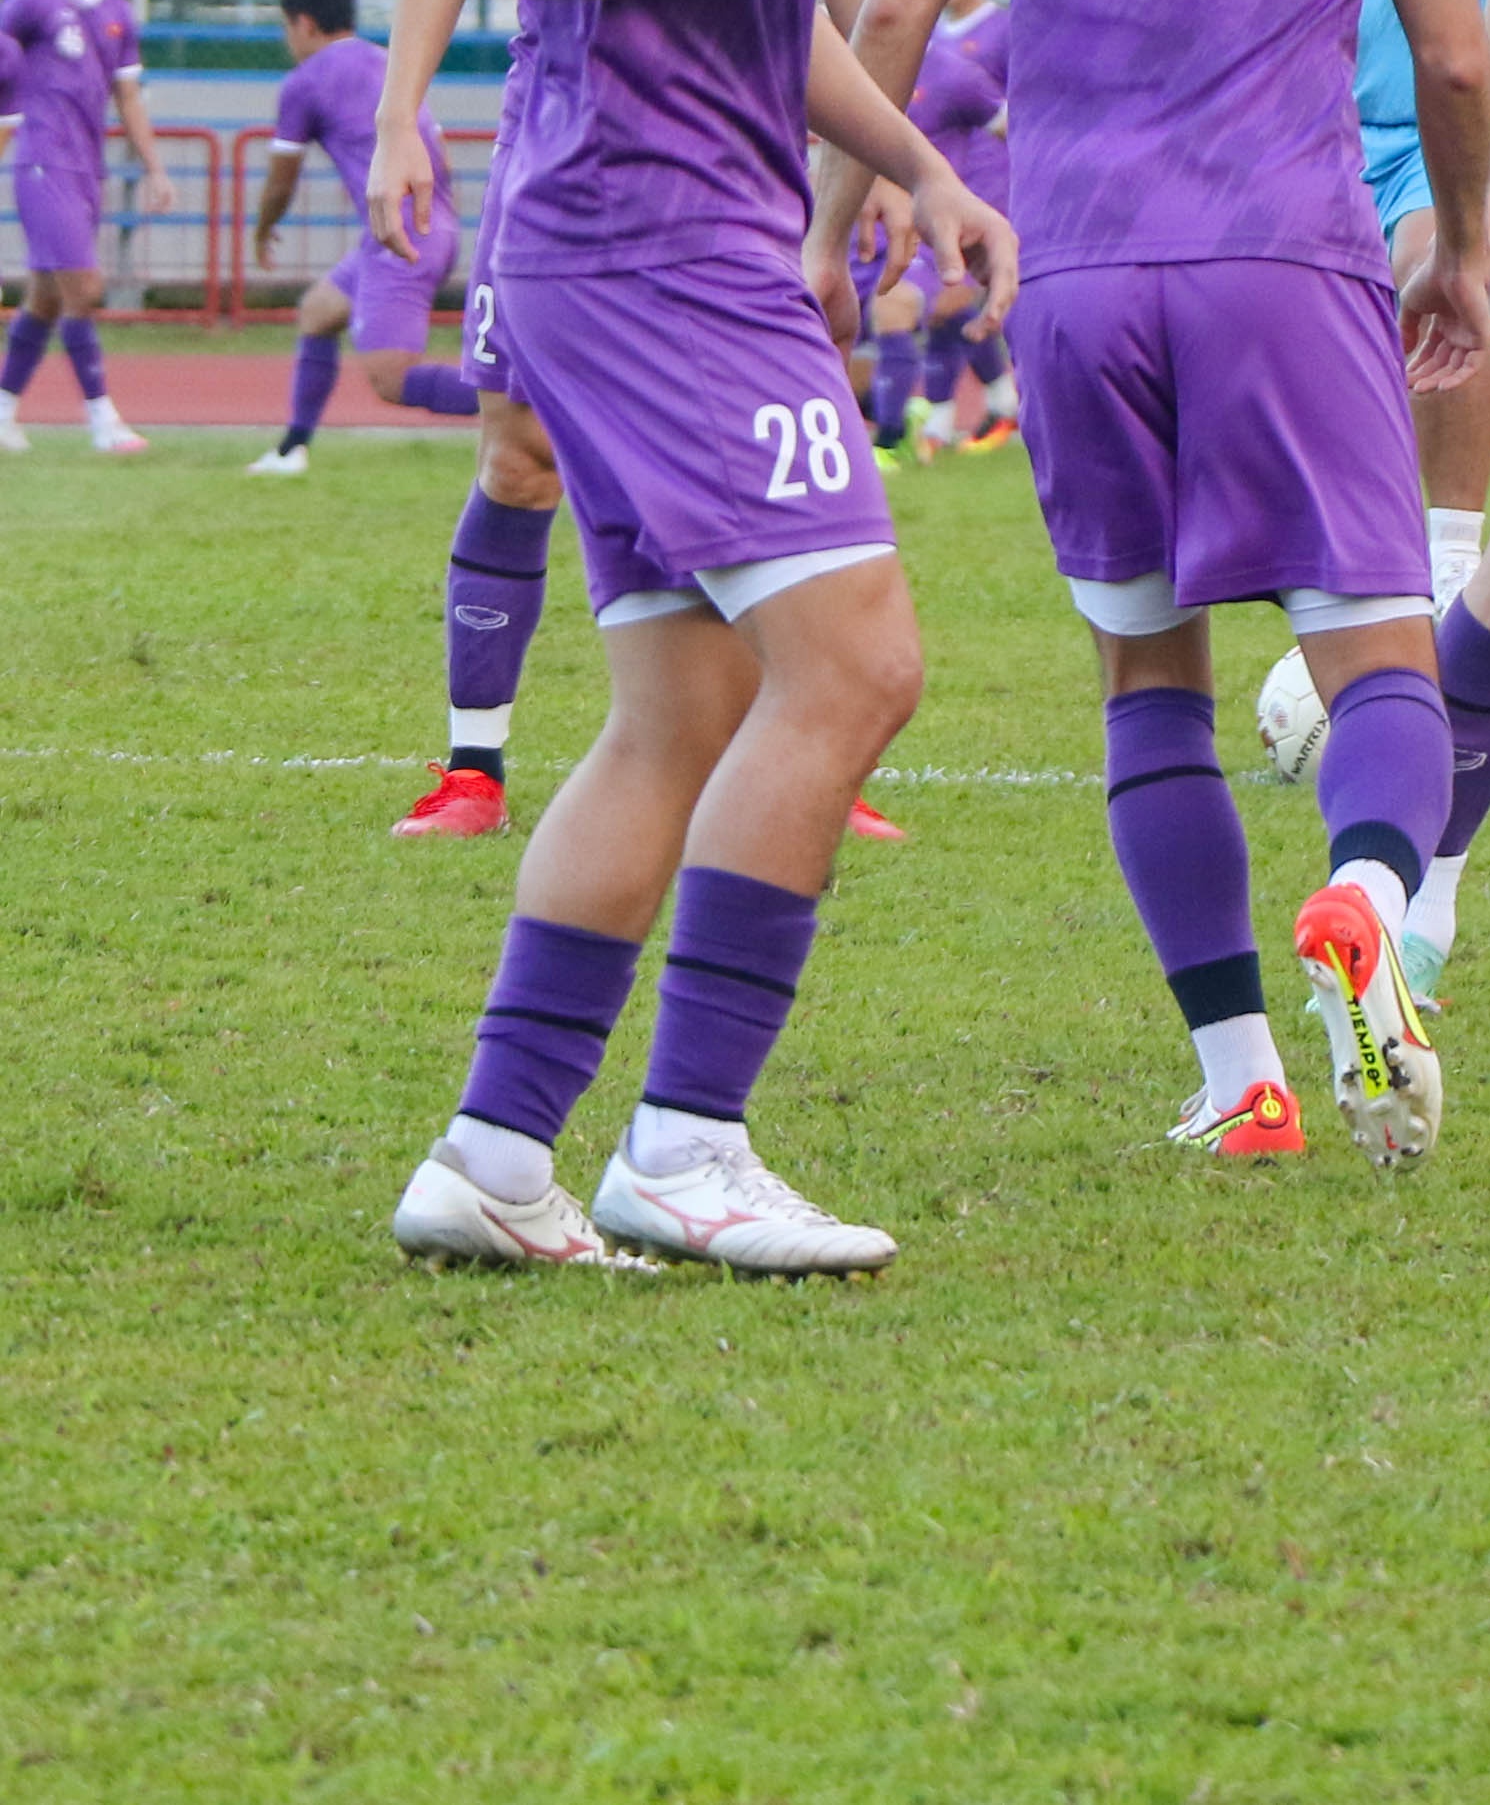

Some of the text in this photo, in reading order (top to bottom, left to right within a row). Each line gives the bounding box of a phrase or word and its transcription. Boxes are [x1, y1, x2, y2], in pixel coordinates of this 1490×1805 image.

[473, 283, 496, 364] 2
[753, 397, 851, 501] 28
[1291, 713, 1329, 775] WARRIX
